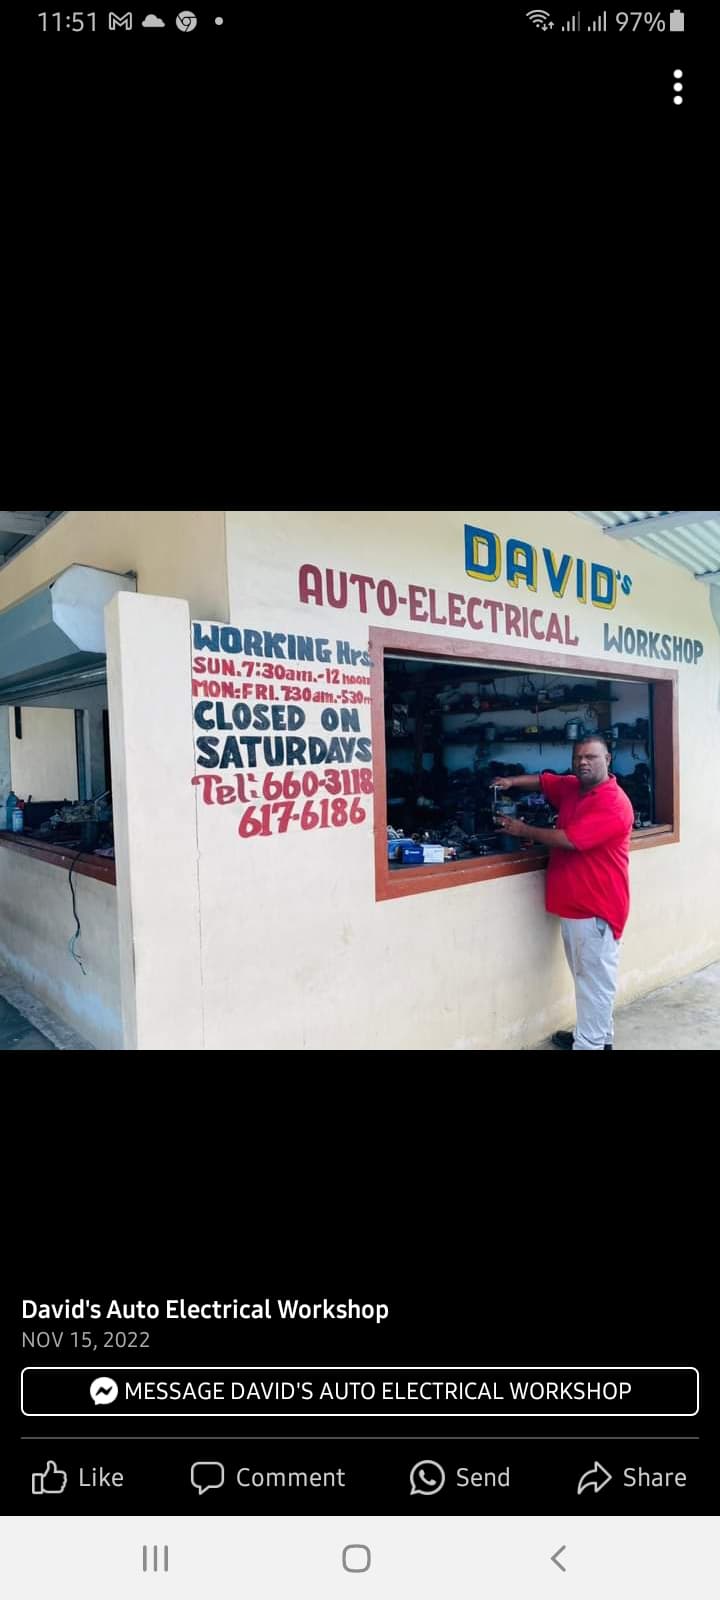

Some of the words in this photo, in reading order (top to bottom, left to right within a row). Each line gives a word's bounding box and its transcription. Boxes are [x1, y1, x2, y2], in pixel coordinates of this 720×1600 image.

[298, 563, 579, 646] AUTO-ELECTRICAL
[604, 623, 703, 664] WORKSHOP
[192, 623, 332, 663] WORKING
[194, 701, 305, 731] CLOSED
[321, 708, 361, 732] ON
[196, 735, 373, 769] SATURDAYS
[191, 773, 259, 805] Tel:
[262, 768, 374, 801] 660-3118
[238, 797, 366, 838] 617-6186
